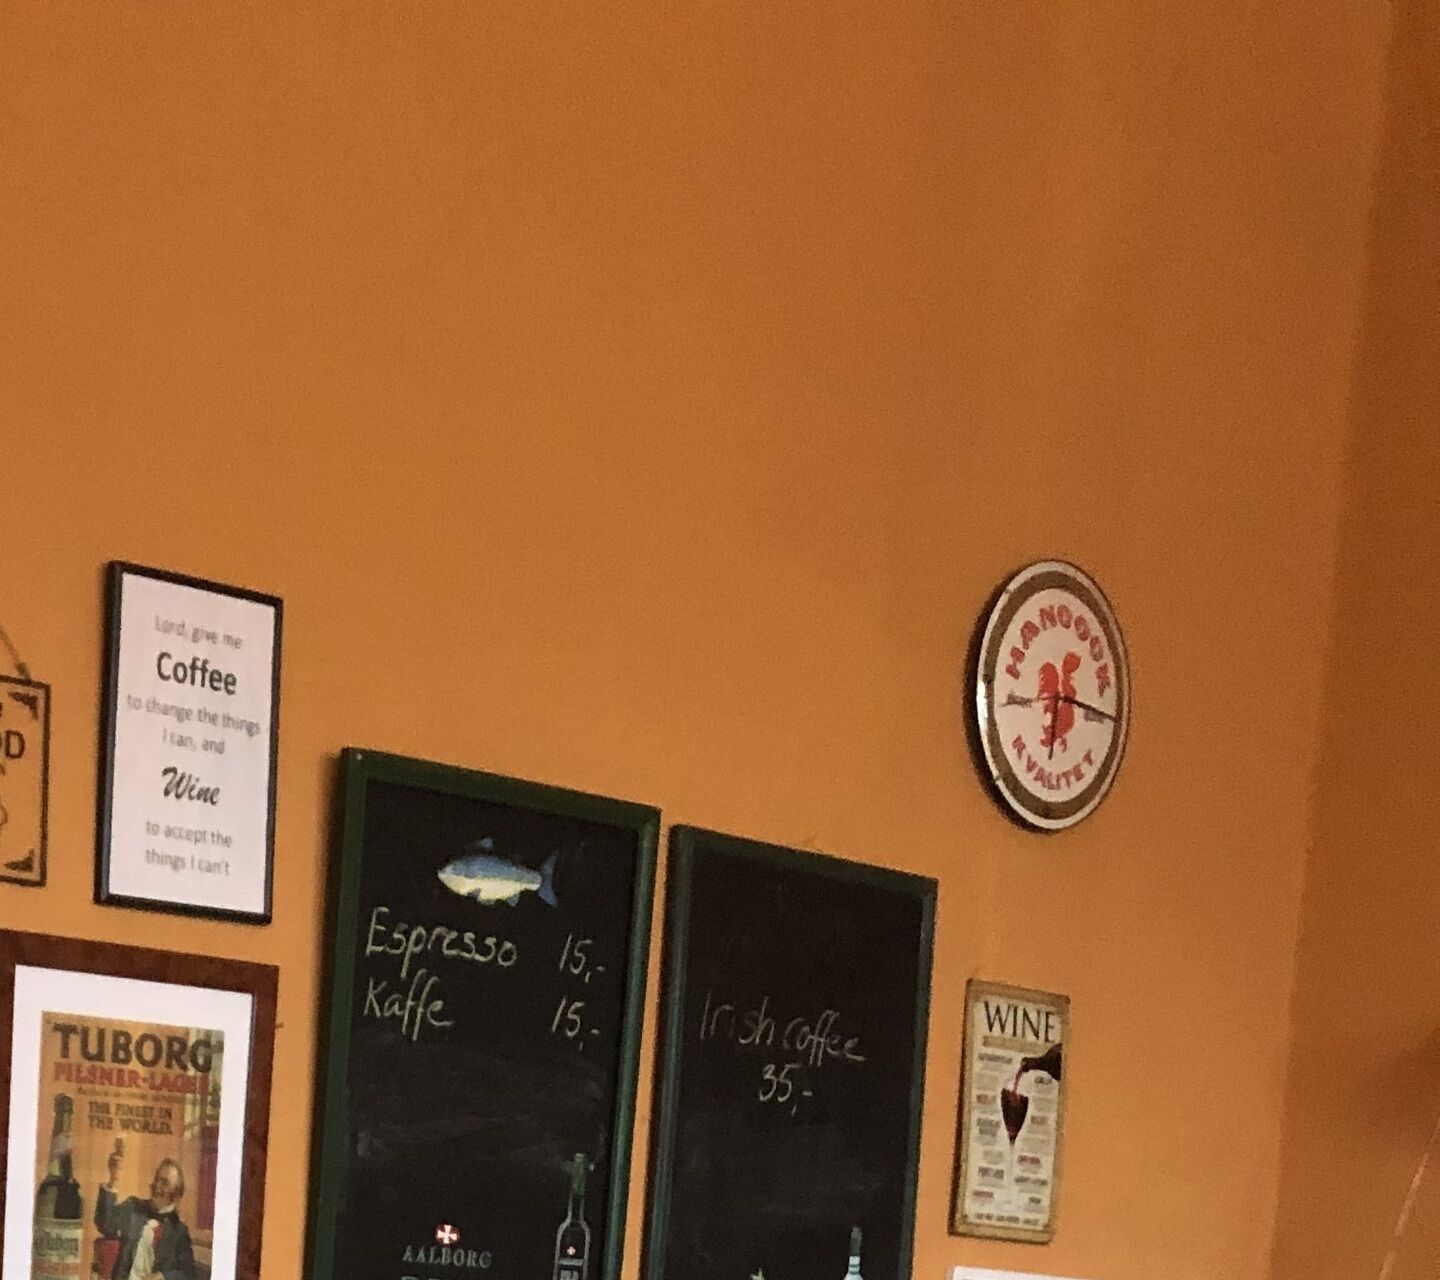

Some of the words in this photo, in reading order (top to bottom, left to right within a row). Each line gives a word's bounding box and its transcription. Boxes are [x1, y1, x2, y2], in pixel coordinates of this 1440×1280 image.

[191, 625, 218, 649] give
[223, 633, 243, 650] me
[157, 651, 237, 696] Coffee
[126, 694, 143, 712] to
[145, 696, 194, 725] change
[197, 705, 219, 726] the
[222, 710, 261, 738] things
[202, 737, 225, 755] and
[1012, 734, 1093, 790] KVALITET
[162, 766, 220, 806] Wine
[146, 818, 160, 836] to
[163, 822, 207, 848] accept
[211, 827, 233, 849] the
[145, 848, 187, 874] things
[198, 856, 230, 876] can't
[364, 906, 517, 980] Espresso
[363, 969, 455, 1041] Kaffe
[984, 1000, 1056, 1044] WINE
[53, 1022, 213, 1074] TUBORG
[88, 1100, 111, 1115] THE
[115, 1103, 155, 1119] FINEST
[160, 1106, 173, 1120] IN
[88, 1115, 113, 1130] THE
[402, 1244, 492, 1269] AALBORG
